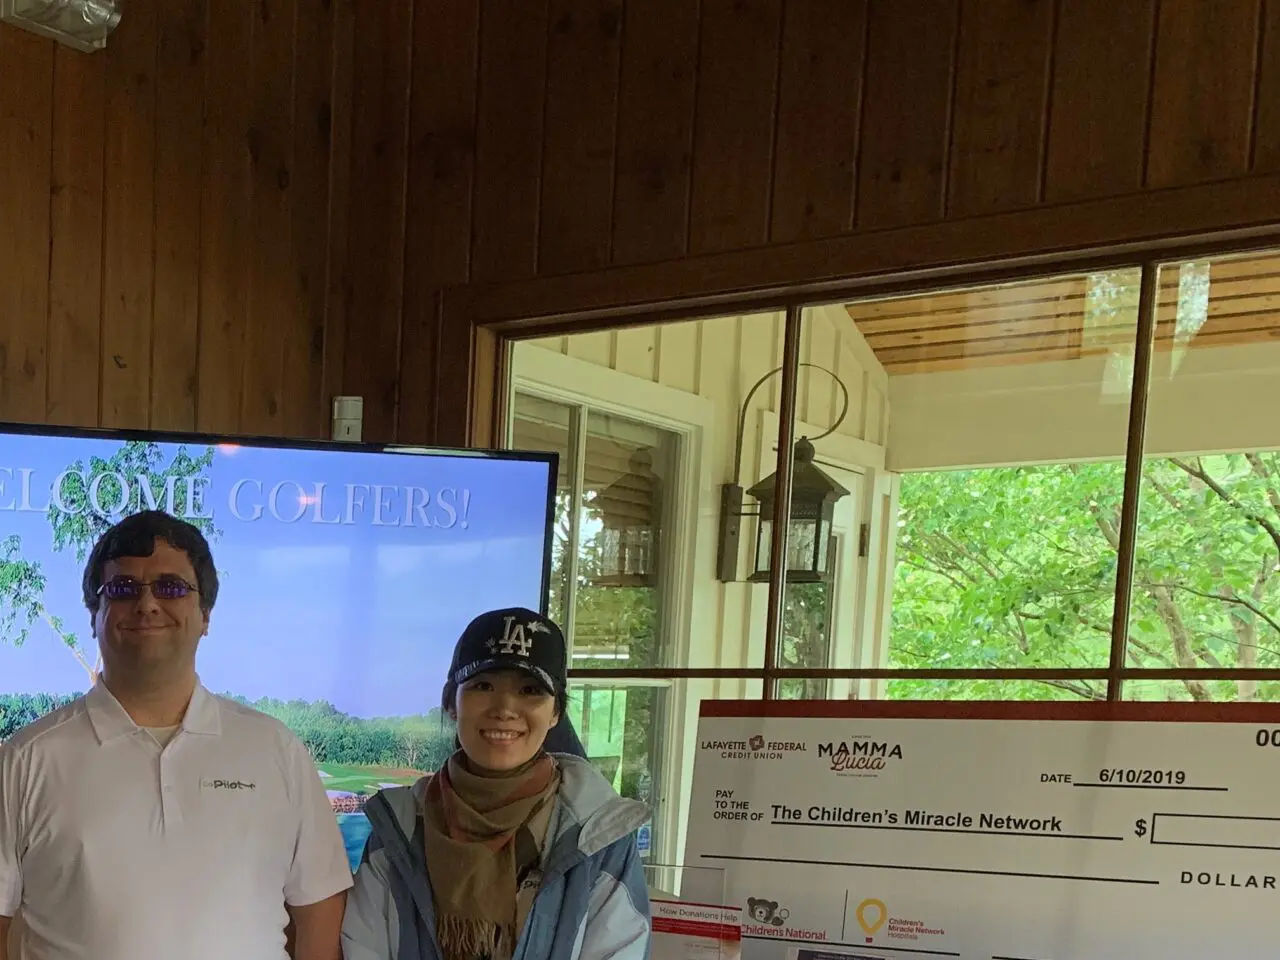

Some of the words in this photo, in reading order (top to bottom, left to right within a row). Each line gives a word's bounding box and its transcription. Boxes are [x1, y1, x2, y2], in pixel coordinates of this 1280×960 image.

[228, 477, 472, 530] GOLFERS!
[498, 615, 533, 658] LA
[701, 740, 747, 751] LAFAYETTE
[767, 741, 808, 752] FEDERAL
[817, 741, 903, 760] MAMMA
[721, 751, 751, 760] CREDIT
[754, 752, 783, 761] UNION
[830, 749, 886, 772] Lucia
[1040, 773, 1073, 784] DATE
[1099, 768, 1186, 785] 6/10/2019
[715, 789, 734, 799] PAY
[715, 800, 728, 809] TO
[731, 801, 750, 810] THE
[713, 811, 748, 821] ORDER
[750, 812, 764, 822] OF
[771, 804, 802, 820] The
[808, 805, 898, 825] Children's
[904, 810, 973, 828] Miracle
[979, 813, 1062, 832] Network
[1134, 818, 1147, 838] $
[659, 906, 678, 916] How
[679, 908, 719, 920] Donations
[720, 912, 738, 923] Help
[785, 927, 826, 941] National
[888, 925, 914, 934] Miracle
[915, 927, 945, 936] Network
